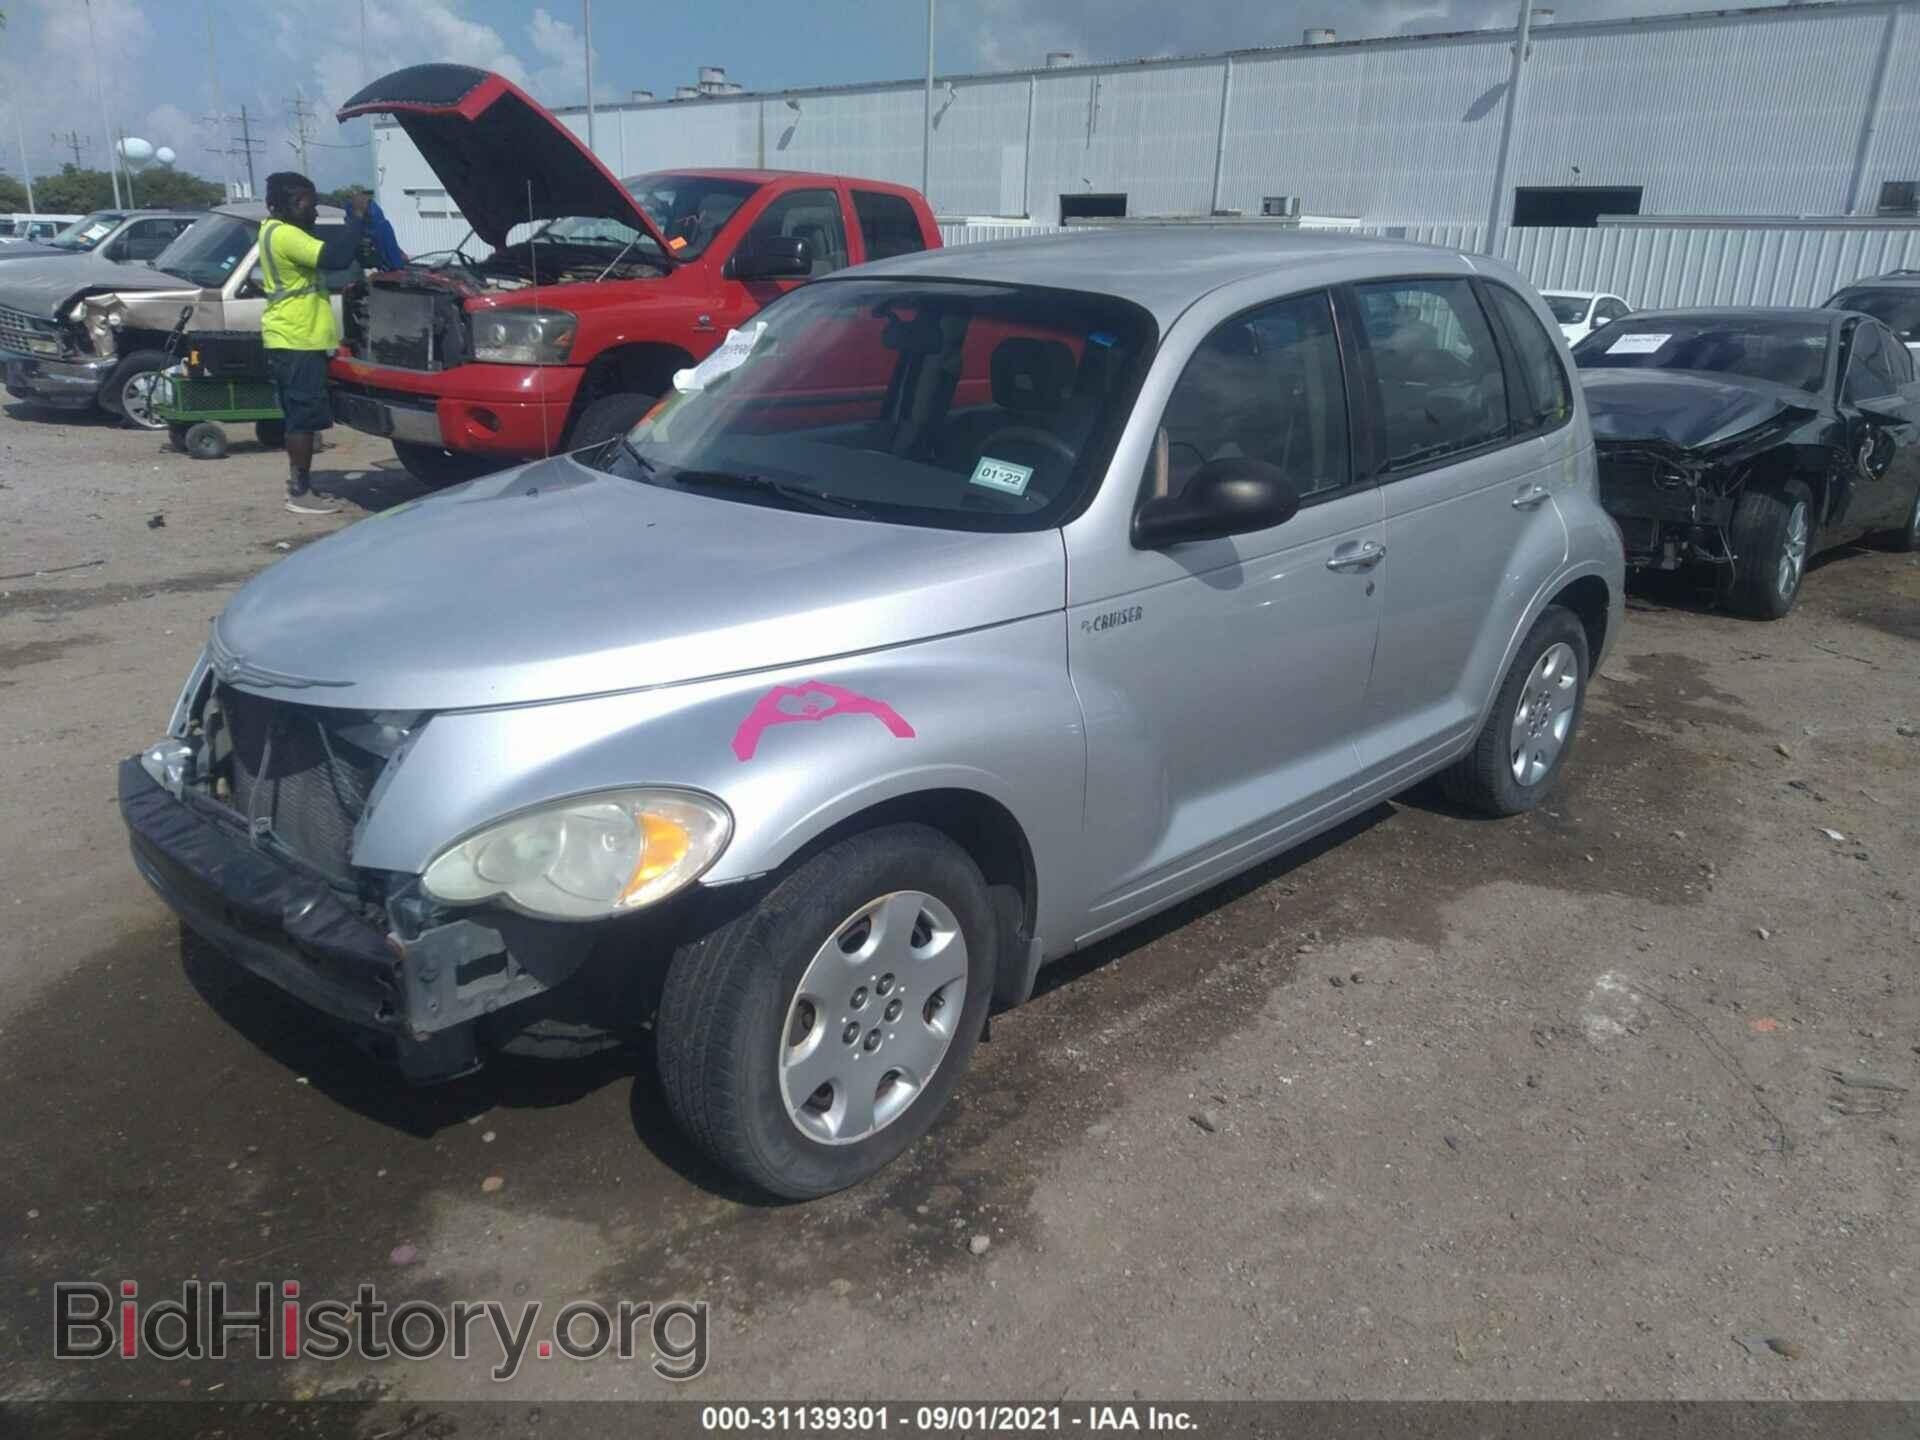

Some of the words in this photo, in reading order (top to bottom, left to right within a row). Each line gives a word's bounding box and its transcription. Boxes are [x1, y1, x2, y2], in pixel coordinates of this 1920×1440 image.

[982, 467, 998, 480] 01
[1003, 472, 1022, 485] 22
[1093, 606, 1143, 632] CRUISER
